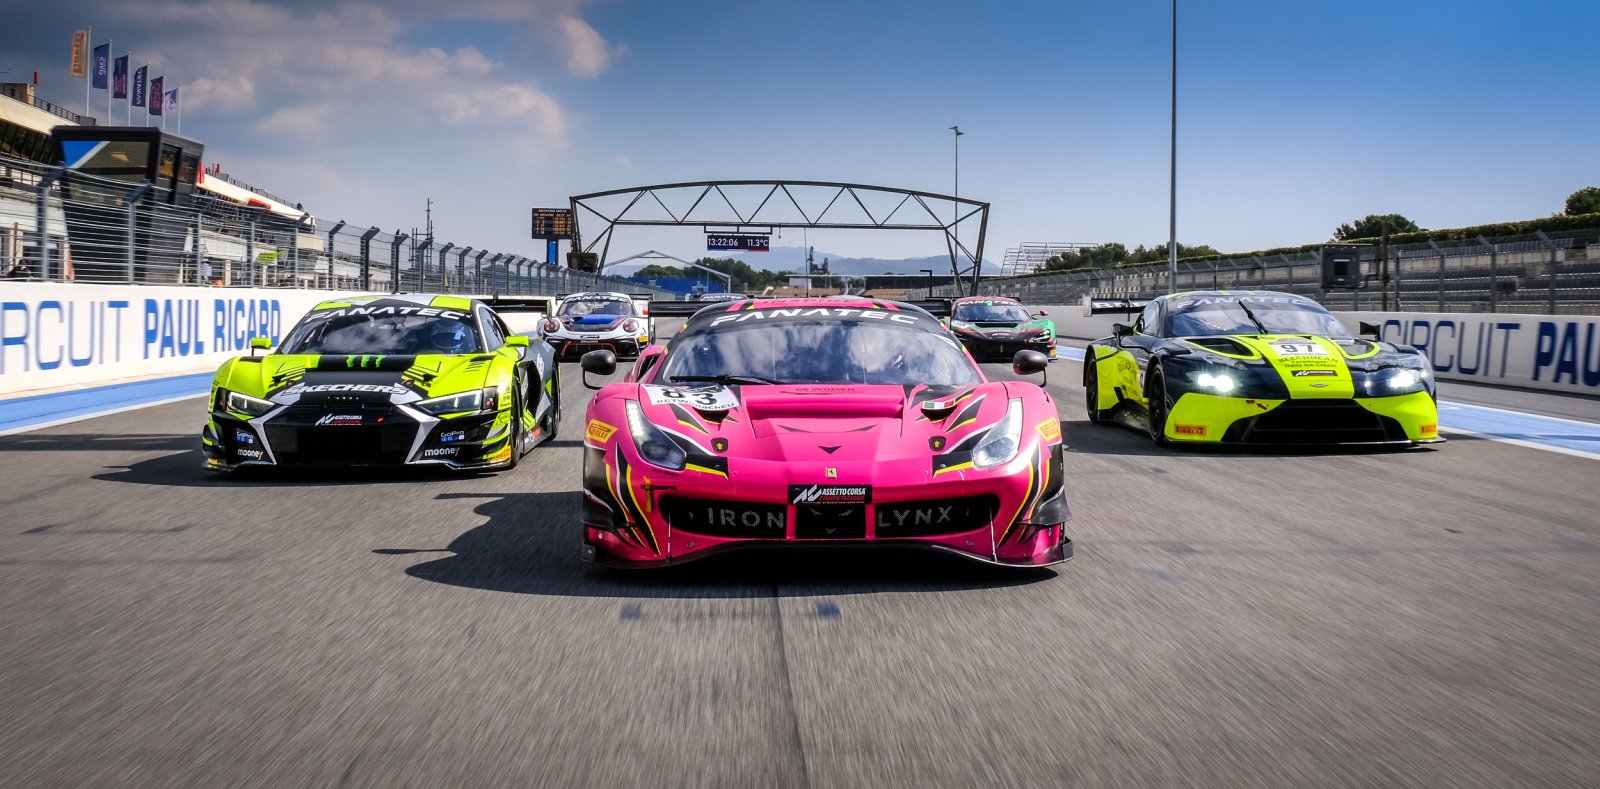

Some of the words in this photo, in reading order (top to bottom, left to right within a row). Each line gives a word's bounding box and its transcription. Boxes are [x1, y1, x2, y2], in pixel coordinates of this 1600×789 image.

[708, 238, 739, 247] 13:22:06
[564, 295, 629, 303] FANATEC
[1177, 297, 1309, 309] FANATEC
[304, 305, 470, 323] FANATEC
[709, 308, 919, 328] FANATEC
[143, 298, 204, 360] PAUL
[212, 298, 281, 353] RICARD
[1280, 344, 1314, 353] 97
[281, 383, 412, 396] SKECHERS
[440, 430, 464, 438] GoPro
[589, 423, 612, 439] PIRELLI
[1176, 425, 1204, 434] PIRELLI
[237, 448, 264, 461] mooney
[424, 447, 460, 457] mooney
[821, 488, 847, 496] ASSETTO
[847, 488, 866, 496] CORSA
[707, 507, 784, 529] IRON
[877, 505, 953, 528] LYNX
